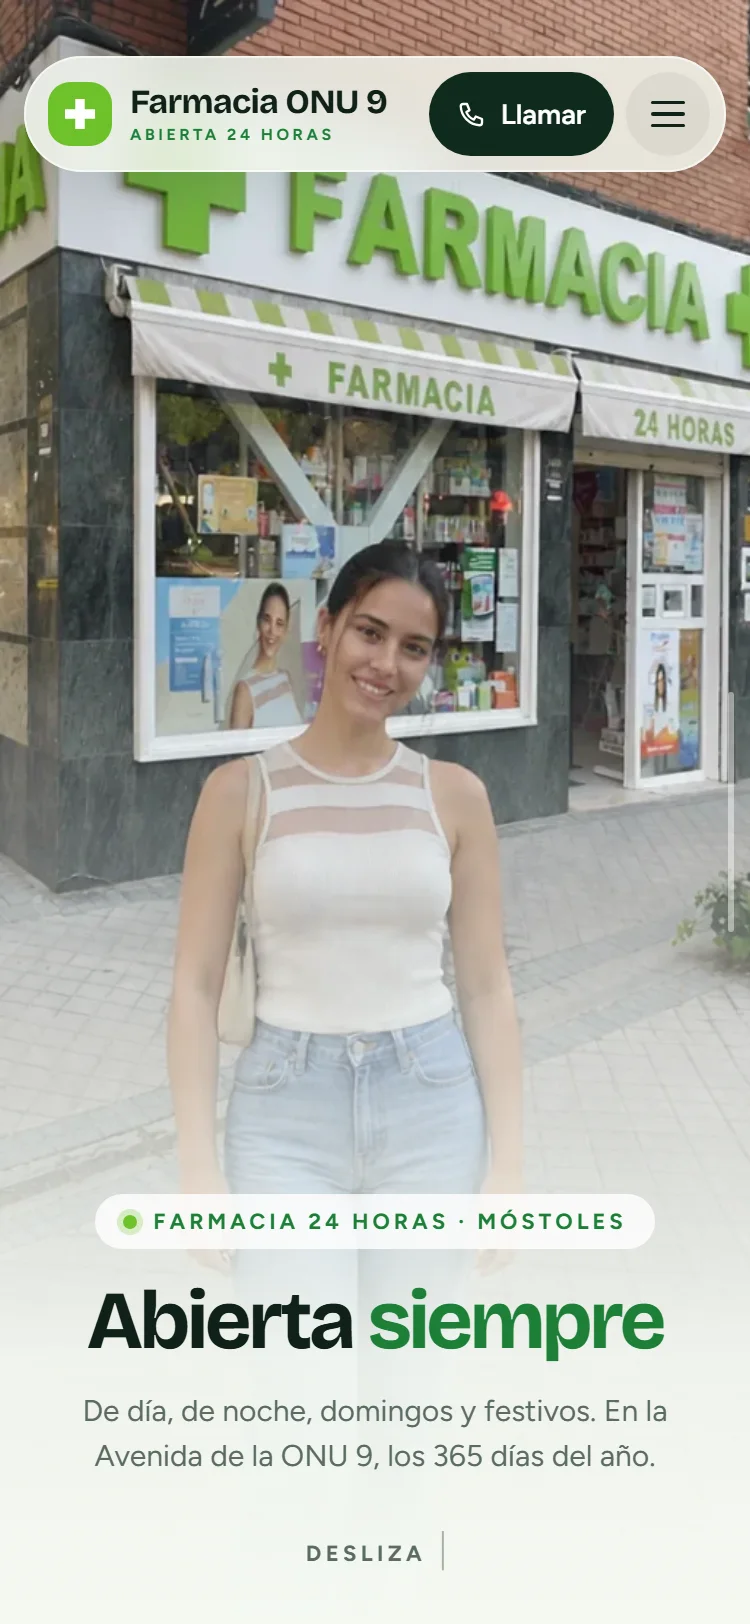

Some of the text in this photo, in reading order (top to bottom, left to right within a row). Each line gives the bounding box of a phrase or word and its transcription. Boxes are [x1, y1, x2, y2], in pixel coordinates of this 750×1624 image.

[289, 171, 710, 341] FARMACIA
[328, 361, 496, 417] FARMACIA
[633, 408, 735, 447] 24 HORAS
